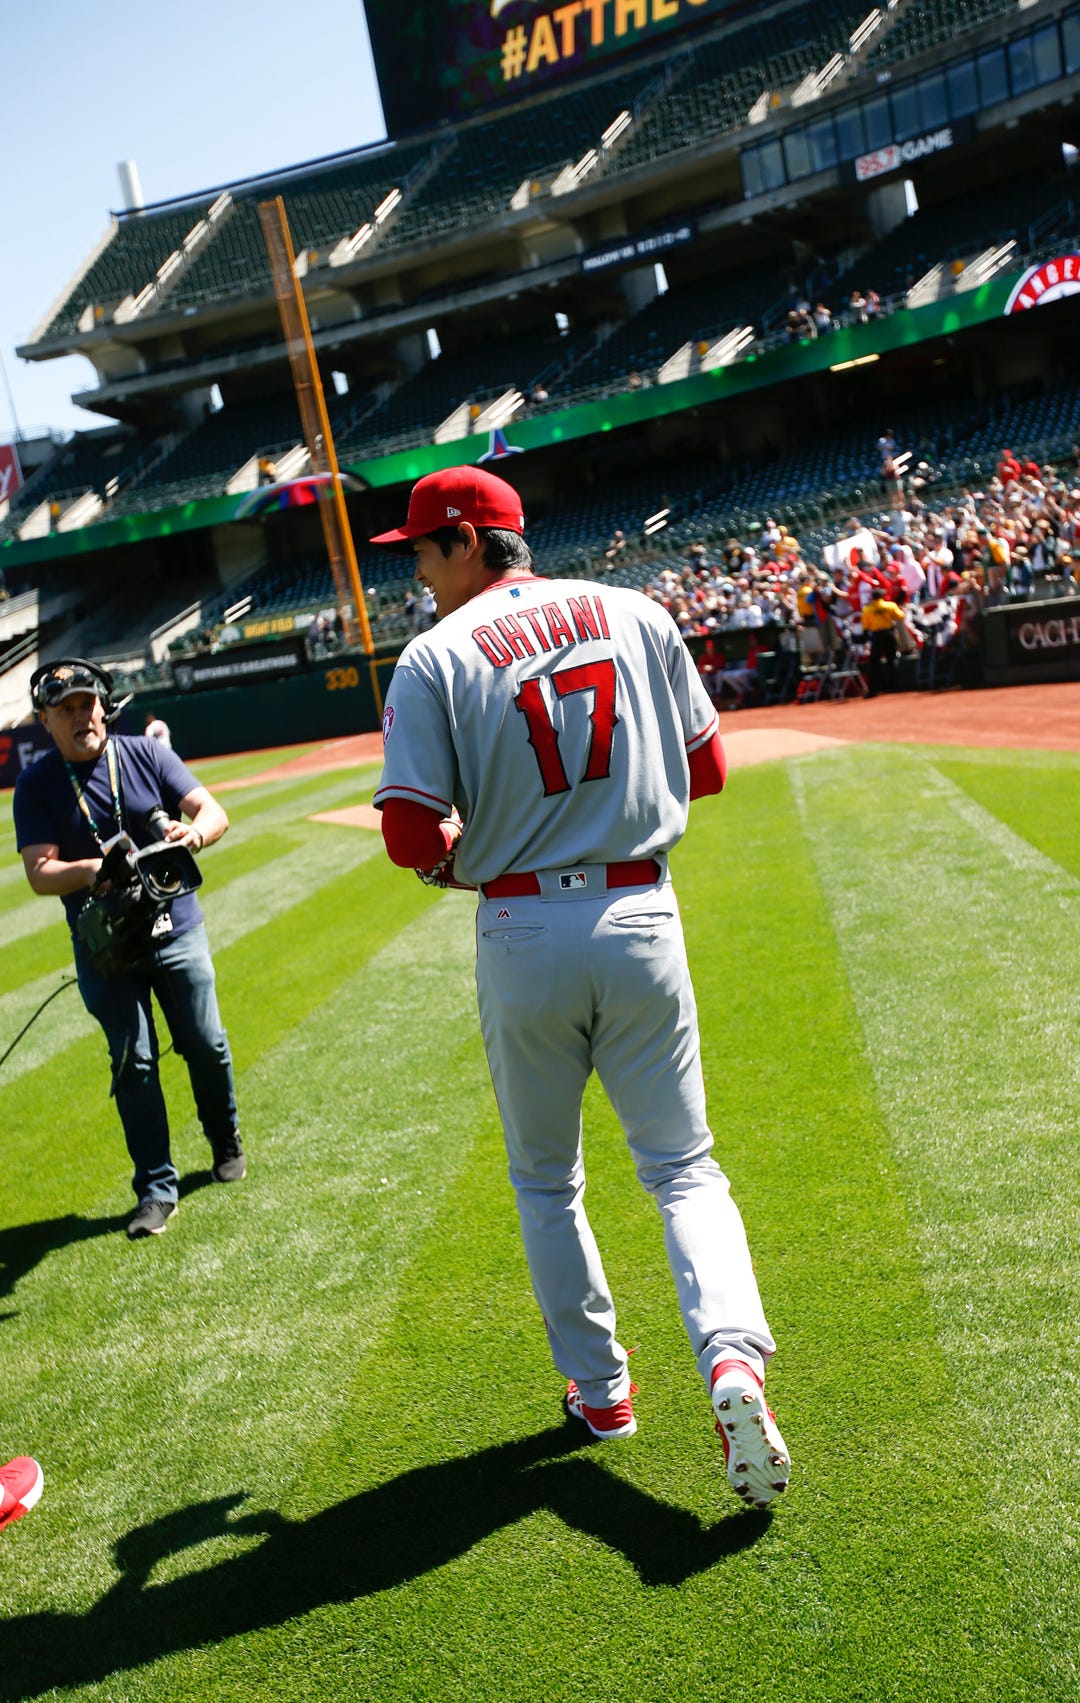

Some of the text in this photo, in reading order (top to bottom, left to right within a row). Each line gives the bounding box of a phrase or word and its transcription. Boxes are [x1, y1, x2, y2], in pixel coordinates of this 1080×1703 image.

[501, 0, 709, 80] #ATTH
[901, 128, 953, 160] GAME
[1018, 258, 1080, 309] ANGE
[472, 595, 611, 669] OHTANI
[325, 666, 359, 690] 330
[513, 658, 619, 798] 17
